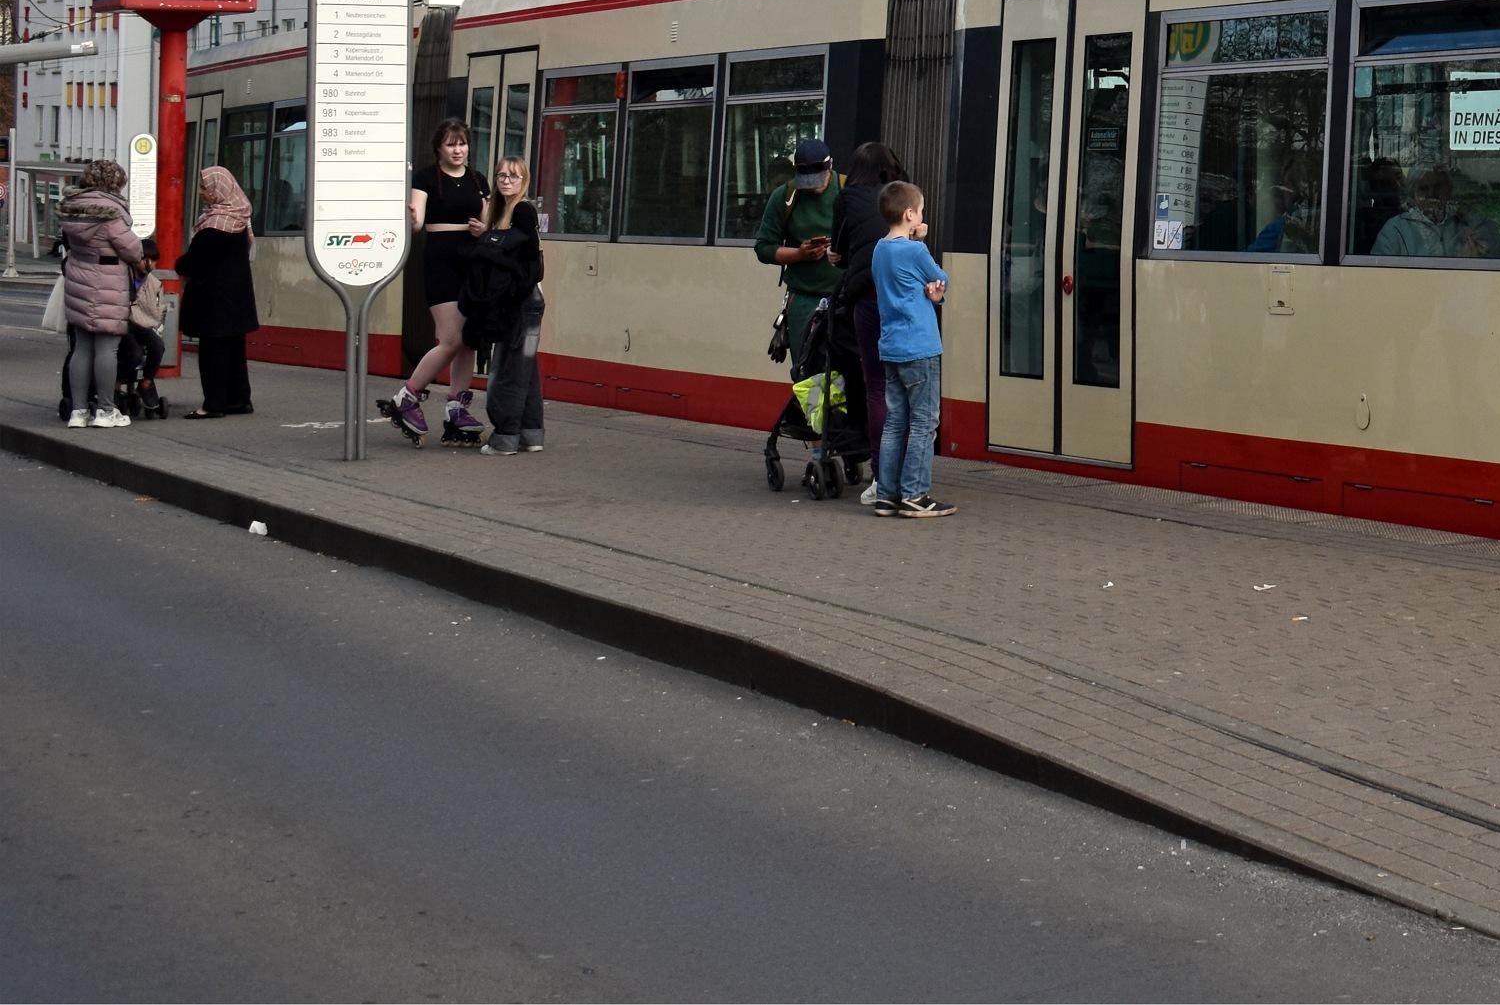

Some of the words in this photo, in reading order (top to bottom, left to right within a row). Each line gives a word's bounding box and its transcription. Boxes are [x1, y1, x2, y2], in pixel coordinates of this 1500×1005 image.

[333, 29, 339, 38] 2
[333, 49, 339, 58] 3
[322, 89, 338, 97] 980
[322, 108, 337, 117] 981
[322, 128, 338, 137] 983
[1454, 131, 1468, 144] IN
[322, 147, 337, 157] 984
[327, 235, 352, 246] SVF
